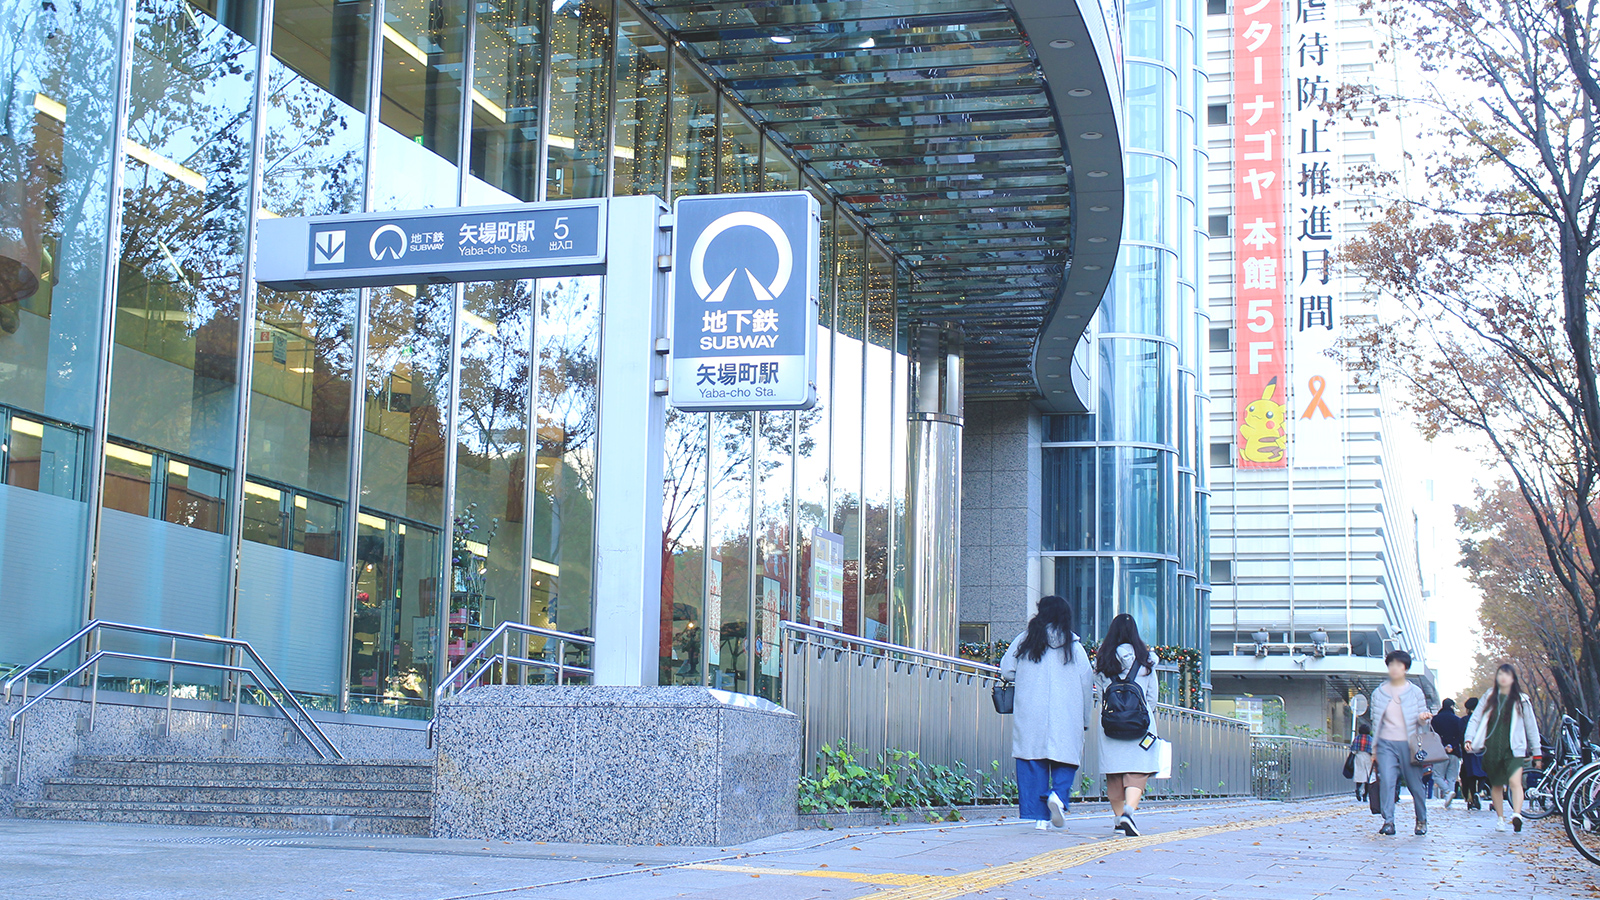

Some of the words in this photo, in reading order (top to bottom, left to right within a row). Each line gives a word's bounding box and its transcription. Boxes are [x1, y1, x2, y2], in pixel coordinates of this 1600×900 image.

[1296, 0, 1334, 332] 虐待防止推進月間
[458, 219, 536, 246] 矢場町駅
[553, 216, 570, 240] 5
[410, 231, 445, 244] 地下鉄
[548, 240, 573, 251] 出入口
[409, 242, 445, 252] SUBWAY
[458, 243, 507, 257] Yaba-cho
[510, 243, 531, 254] Sta.
[701, 308, 779, 333] 地下鉄
[699, 334, 780, 350] SUBWAY
[696, 362, 779, 386] 矢場町駅
[698, 387, 751, 399] Yaba-cho
[755, 386, 777, 397] Sta.
